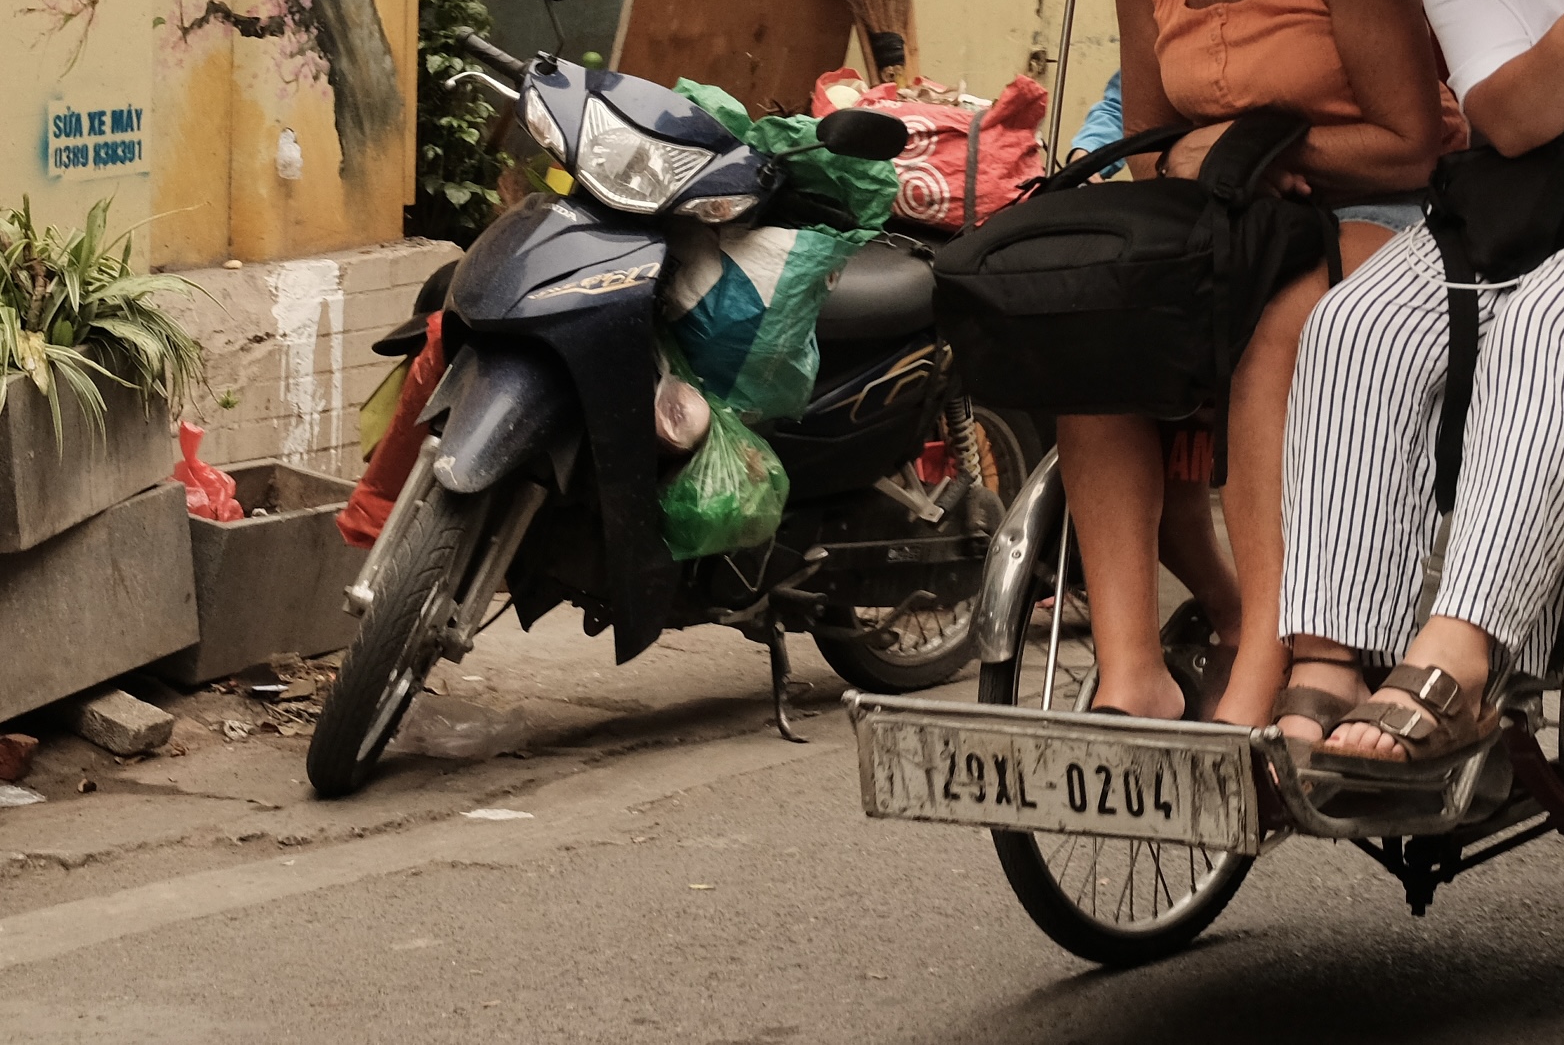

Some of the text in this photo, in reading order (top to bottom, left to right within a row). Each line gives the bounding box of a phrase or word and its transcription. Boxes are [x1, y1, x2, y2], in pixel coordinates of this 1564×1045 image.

[87, 110, 107, 137] XE
[110, 103, 143, 135] MÁY
[54, 143, 89, 169] 0389
